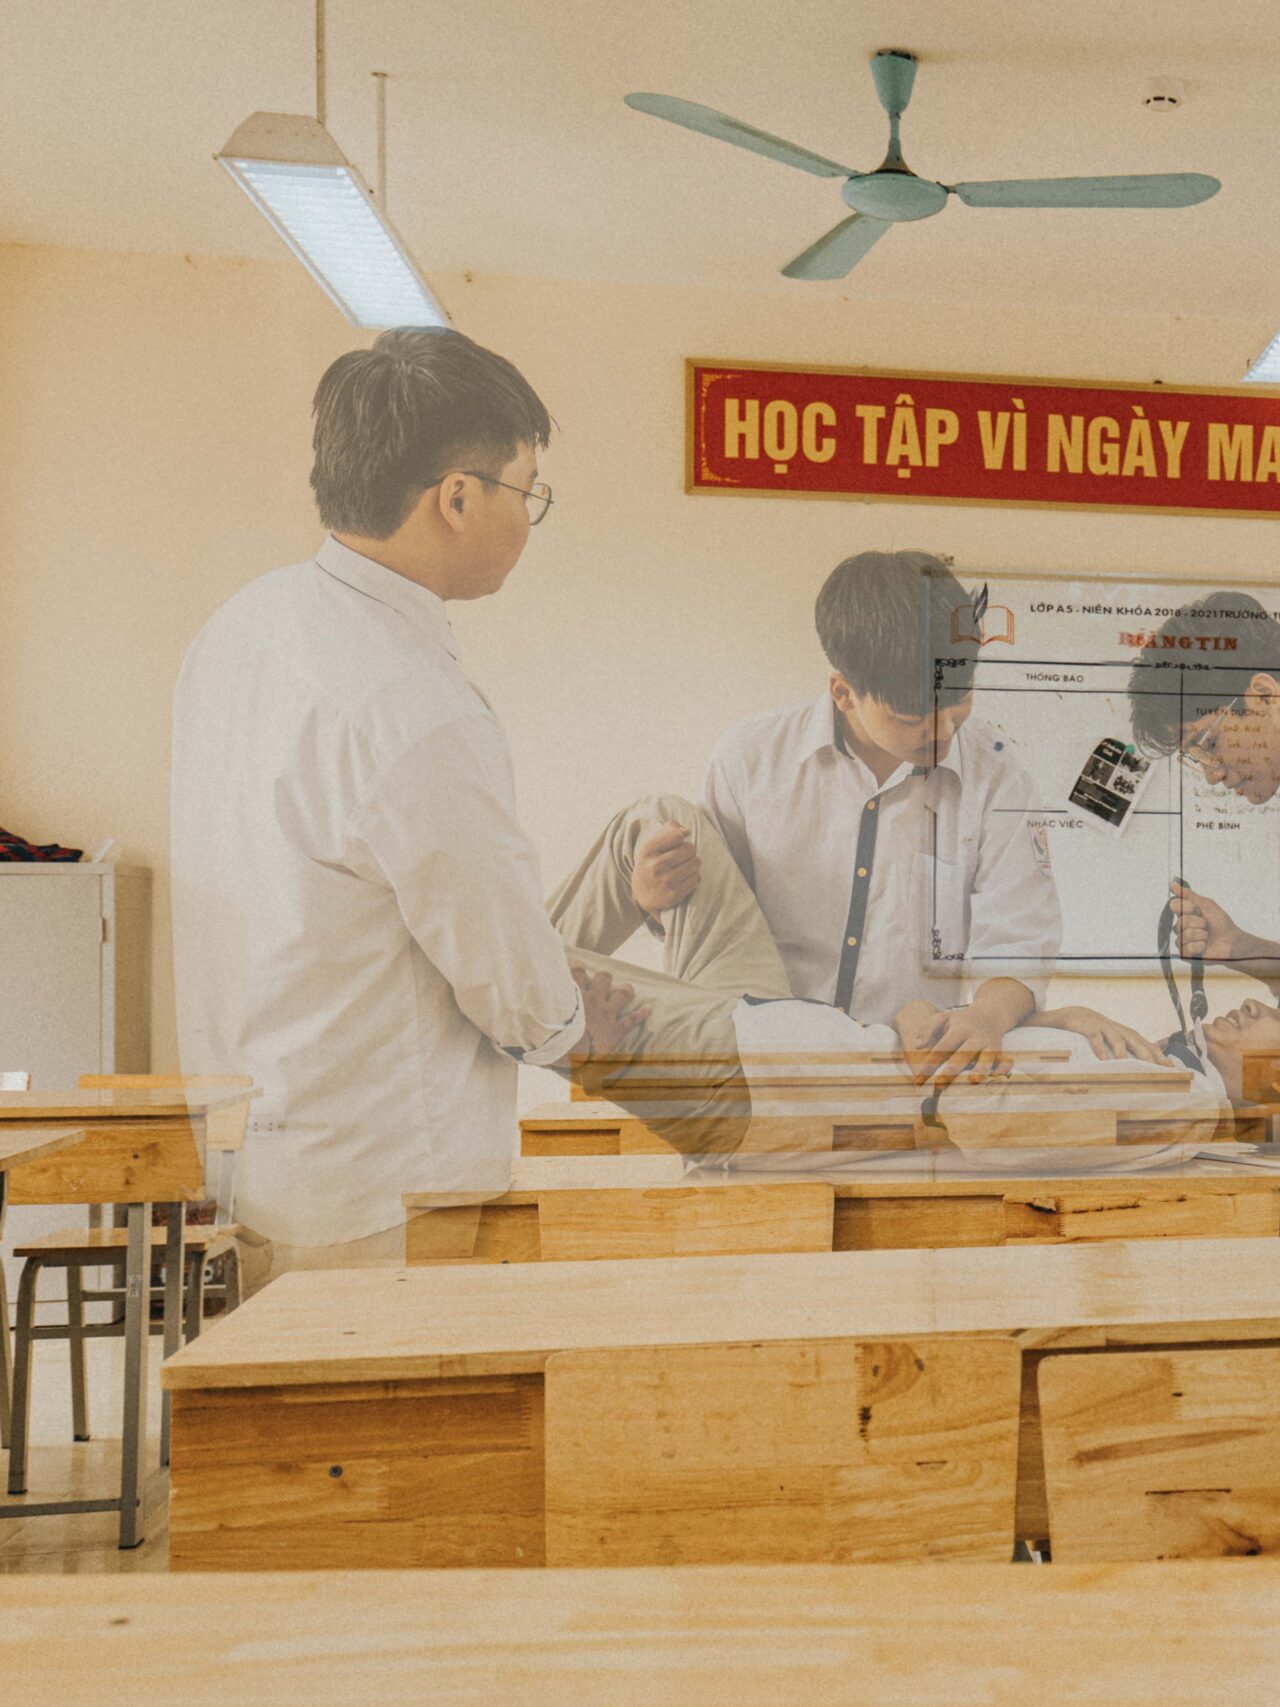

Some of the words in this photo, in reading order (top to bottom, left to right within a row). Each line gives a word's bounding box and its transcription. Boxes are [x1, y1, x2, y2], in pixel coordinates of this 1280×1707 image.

[725, 398, 836, 474] HỌC
[856, 394, 959, 479] TẬP
[978, 399, 1026, 470] VÌ
[1048, 405, 1189, 479] NGÀY
[1082, 603, 1112, 615] NIÊN
